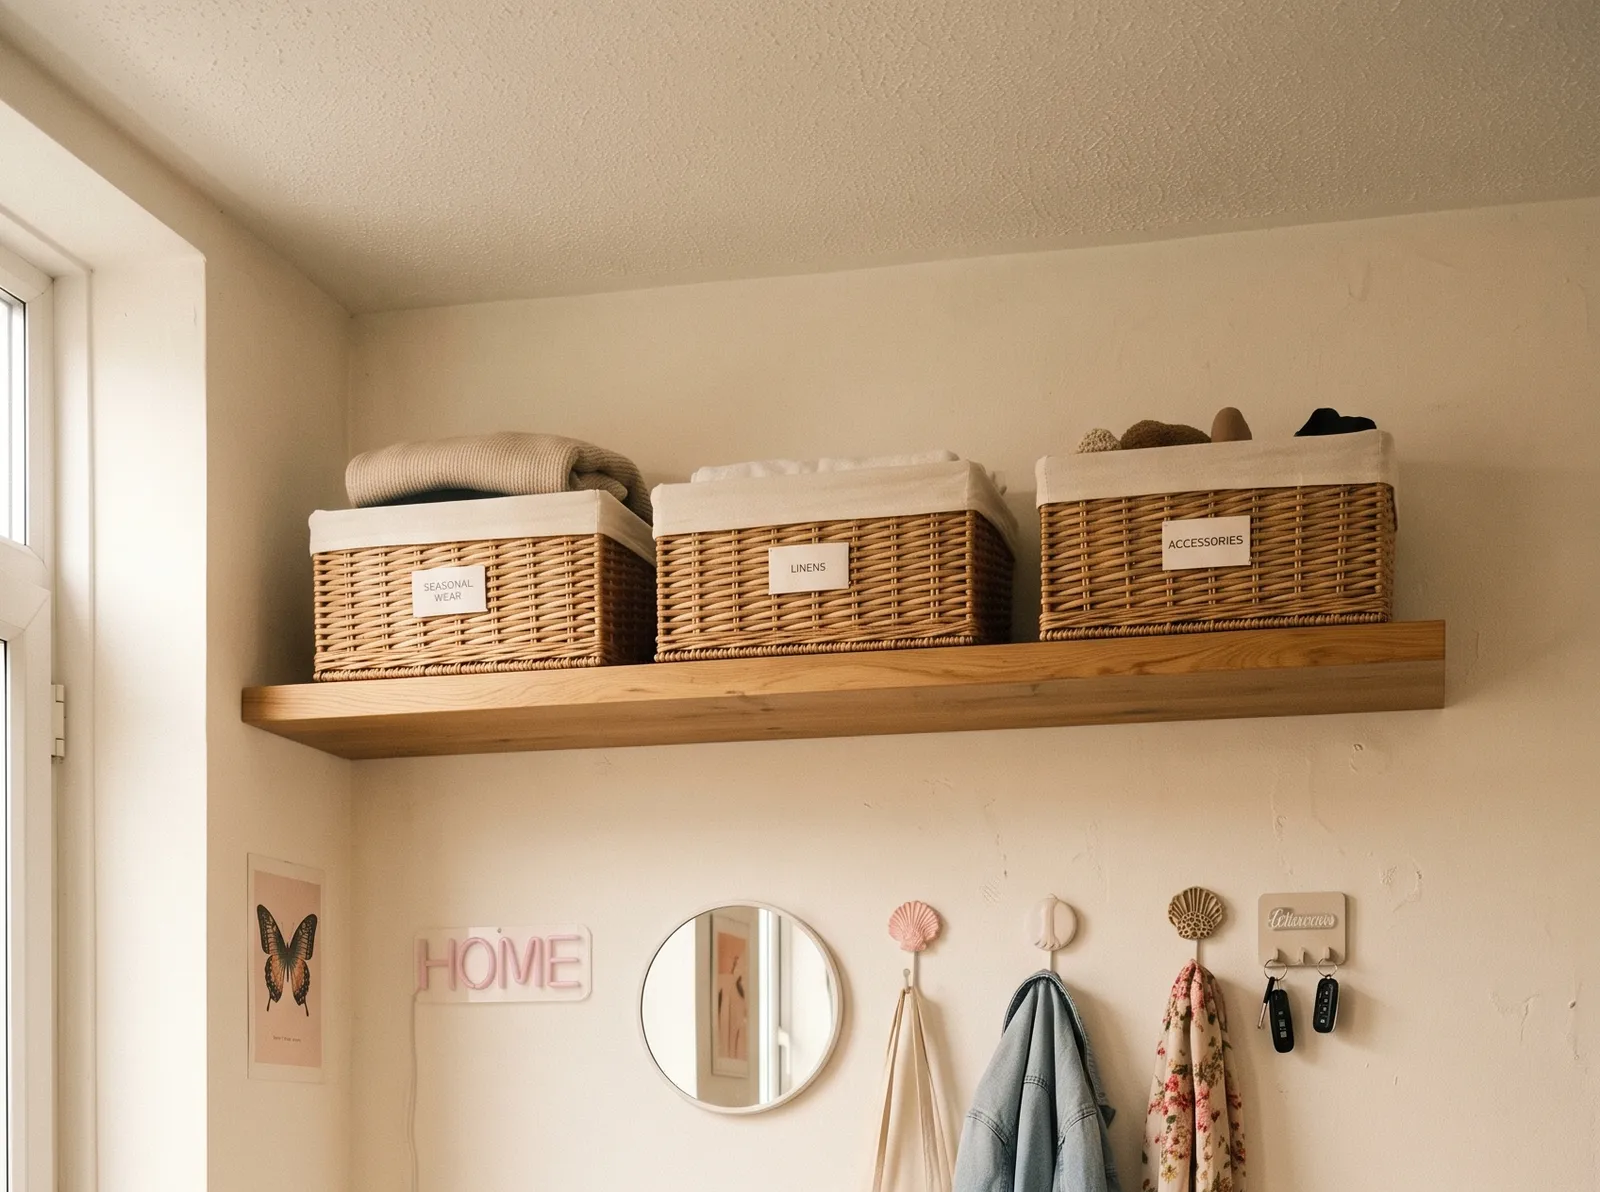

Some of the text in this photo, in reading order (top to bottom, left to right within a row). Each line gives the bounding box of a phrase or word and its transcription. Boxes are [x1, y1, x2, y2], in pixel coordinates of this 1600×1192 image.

[1168, 535, 1244, 549] ACCESSORIES
[790, 562, 826, 574] LINENS
[423, 579, 474, 592] SEASONAL
[434, 592, 462, 602] WEAR
[416, 935, 583, 991] HOME
